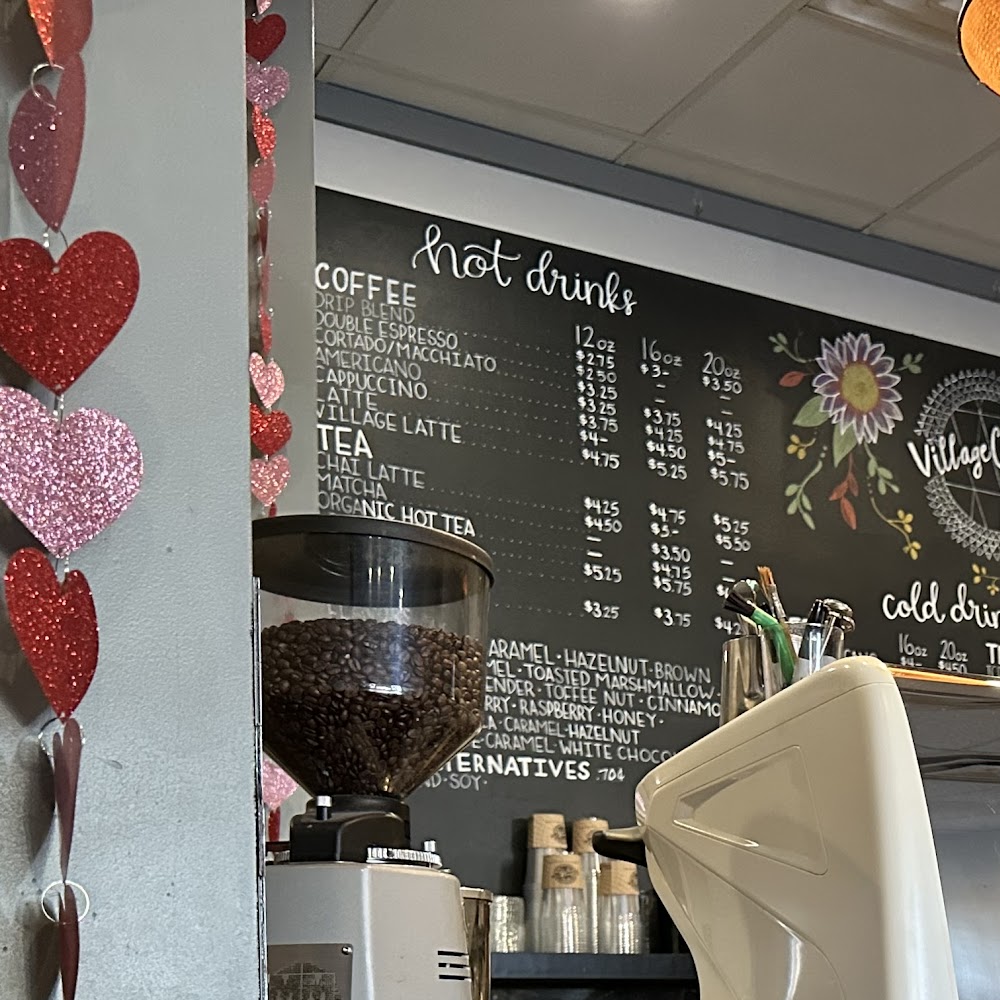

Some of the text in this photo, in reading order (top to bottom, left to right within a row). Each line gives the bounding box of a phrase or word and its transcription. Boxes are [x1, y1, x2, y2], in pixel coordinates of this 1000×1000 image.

[314, 262, 416, 308] COFFEE
[412, 223, 637, 316] hot drinks
[315, 290, 415, 325] DRIP BLEND
[315, 309, 458, 350] DOUBLE ESPRESSO
[315, 347, 421, 381] AMERICANO
[316, 365, 428, 400] CAPPUCCINO
[316, 404, 462, 443] VILLAGE LATTE
[317, 423, 373, 459] TEA
[318, 451, 425, 489] CHAI LATTE
[318, 473, 388, 500] MATCHA
[318, 491, 476, 538] ORGANIC HOT TEA
[882, 581, 946, 624] cold
[488, 638, 711, 683] ARAMEL HAZELNUT BROWN
[485, 676, 720, 717] ENDER TOFFEE NUT CINNAMO
[523, 663, 591, 686] TOASTED
[595, 673, 715, 699] MARSHMALLOW
[504, 716, 566, 738] CARAMEL
[568, 723, 640, 745] HAZELNUT
[519, 699, 657, 728] RASPBERRY HONEY
[485, 732, 555, 754] CARAMEL
[559, 739, 613, 760] WHITE
[617, 746, 674, 764] CHOCO
[449, 773, 482, 791] SOY
